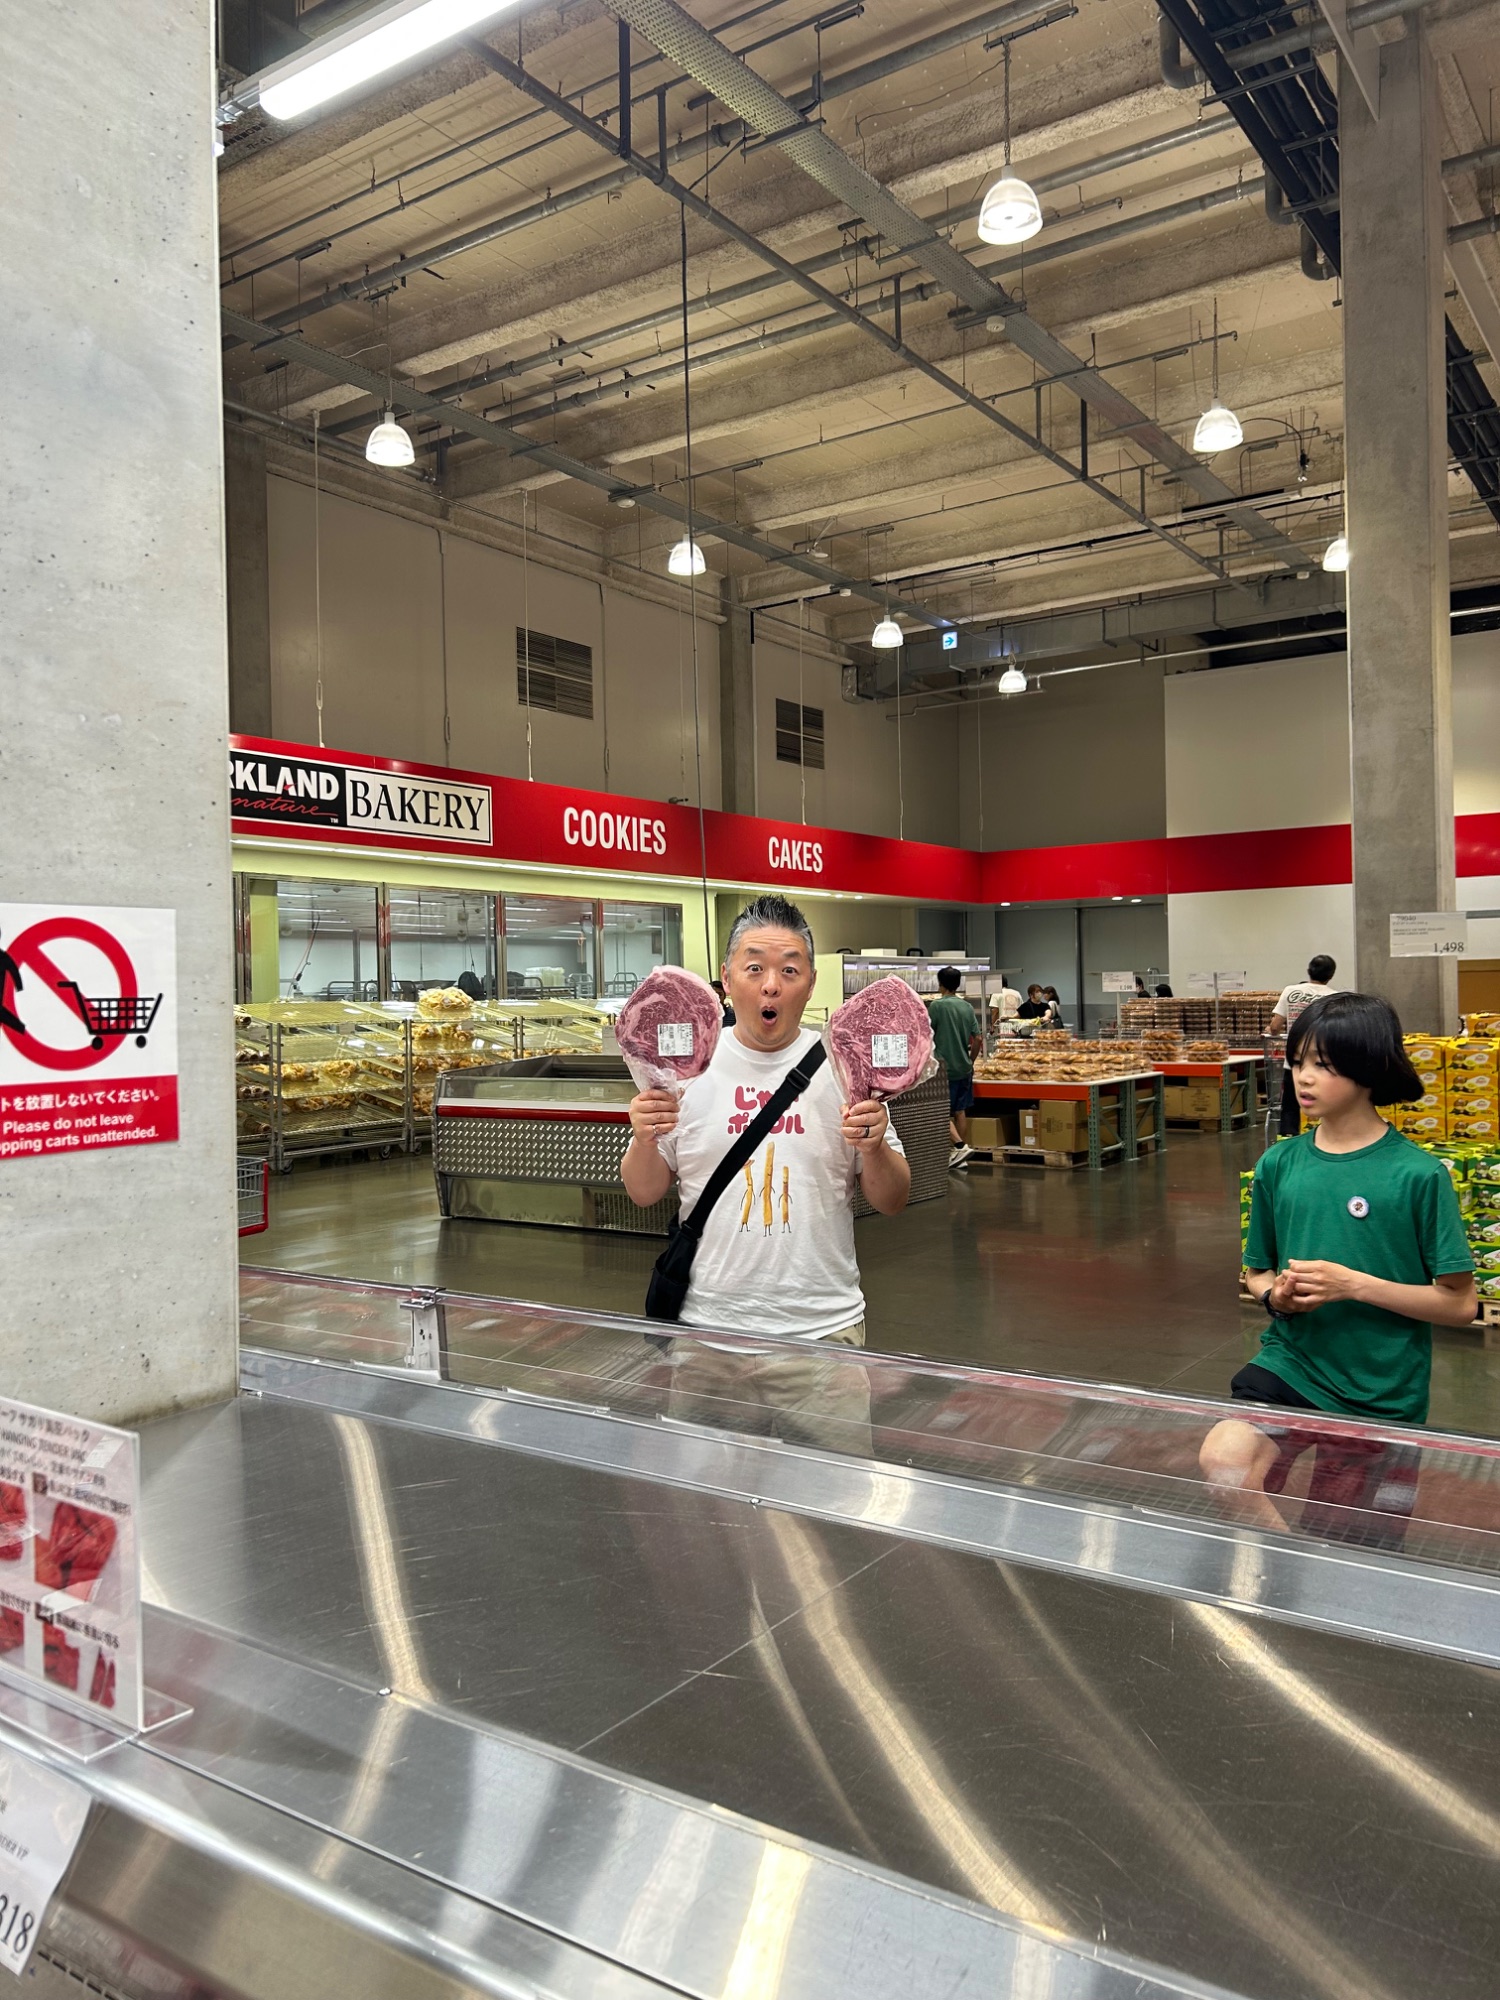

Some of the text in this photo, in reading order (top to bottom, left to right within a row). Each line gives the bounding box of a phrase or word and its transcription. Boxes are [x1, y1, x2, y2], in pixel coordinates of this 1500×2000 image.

[350, 779, 485, 831] BAKERY
[563, 806, 667, 855] COOKIES
[768, 836, 823, 873] CAKES
[1433, 941, 1465, 954] 1,498
[3, 1113, 134, 1135] Please do not leave
[0, 1126, 159, 1156] pping carts unattended.
